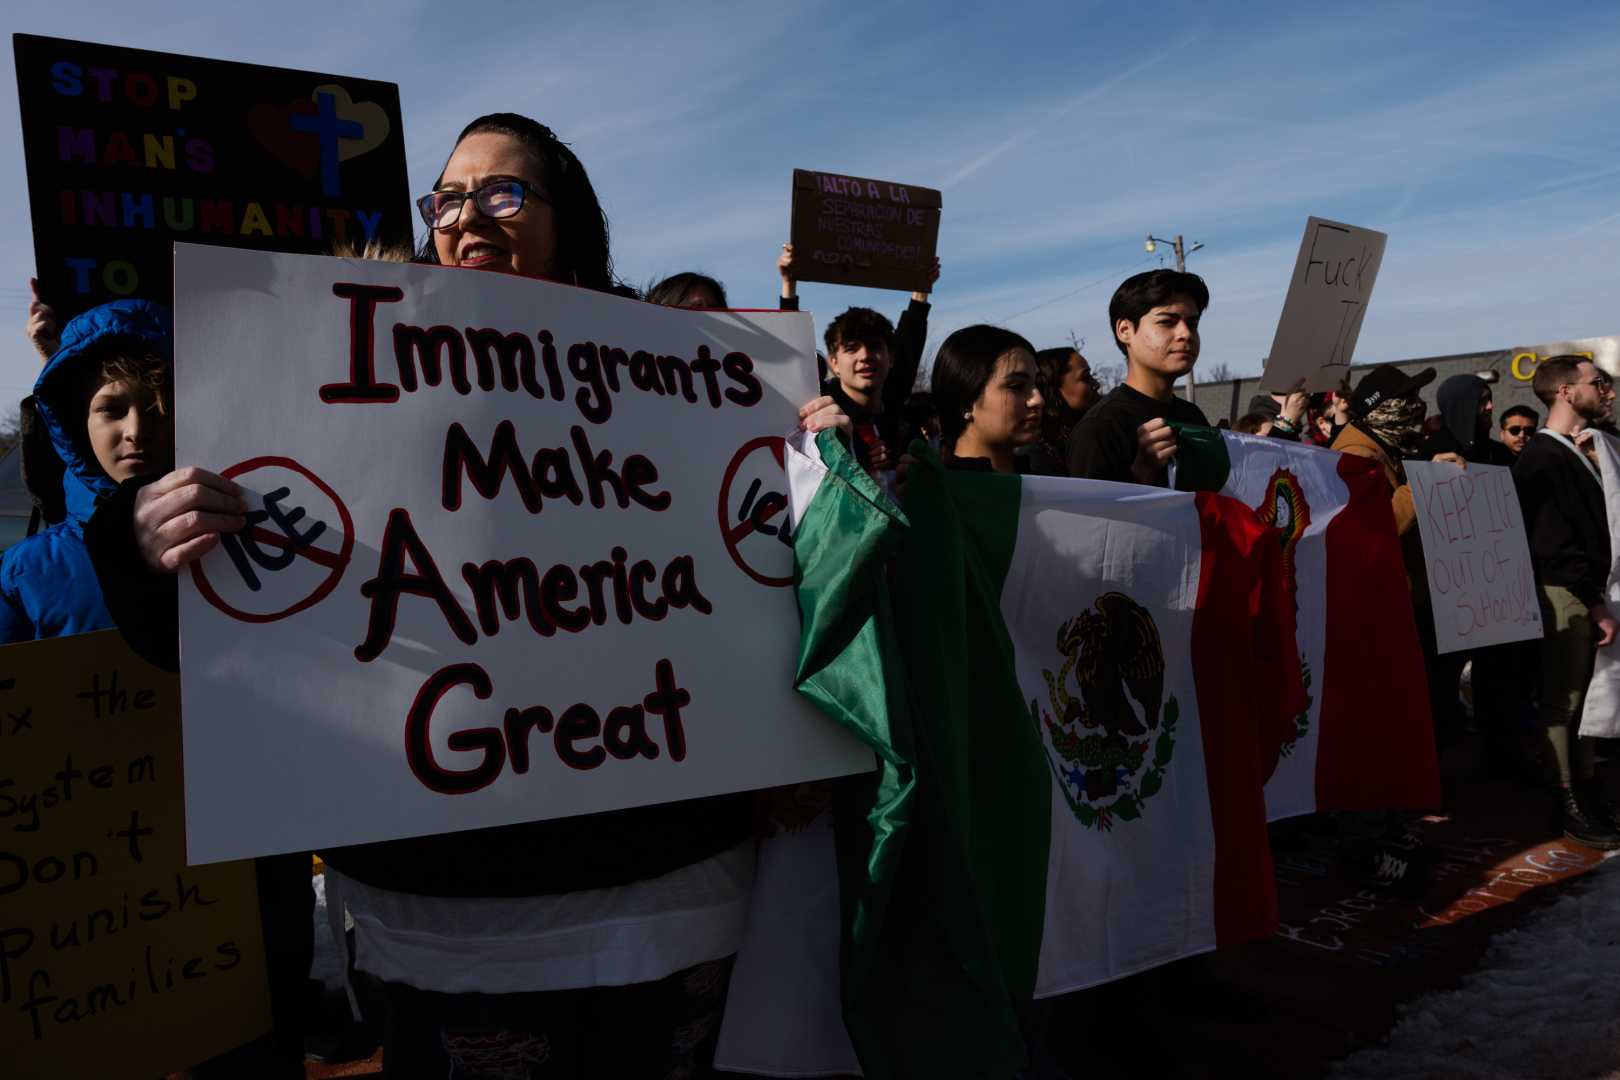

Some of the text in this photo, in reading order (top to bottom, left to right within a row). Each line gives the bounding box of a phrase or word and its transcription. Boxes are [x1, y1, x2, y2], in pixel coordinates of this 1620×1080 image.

[49, 58, 198, 112] STOP
[56, 124, 217, 174] MAN'S
[62, 191, 384, 240] INHUMANITY
[867, 182, 880, 199] A
[889, 185, 910, 204] LA
[64, 256, 141, 296] TO
[319, 283, 762, 423] Immigrants
[442, 420, 671, 513] Make
[220, 487, 326, 591] ICE
[1416, 472, 1476, 546] KEEP
[354, 508, 712, 662] America
[1433, 539, 1511, 594] OUT OF
[75, 668, 156, 719] the
[405, 659, 690, 794] Great
[20, 941, 242, 1040] families
